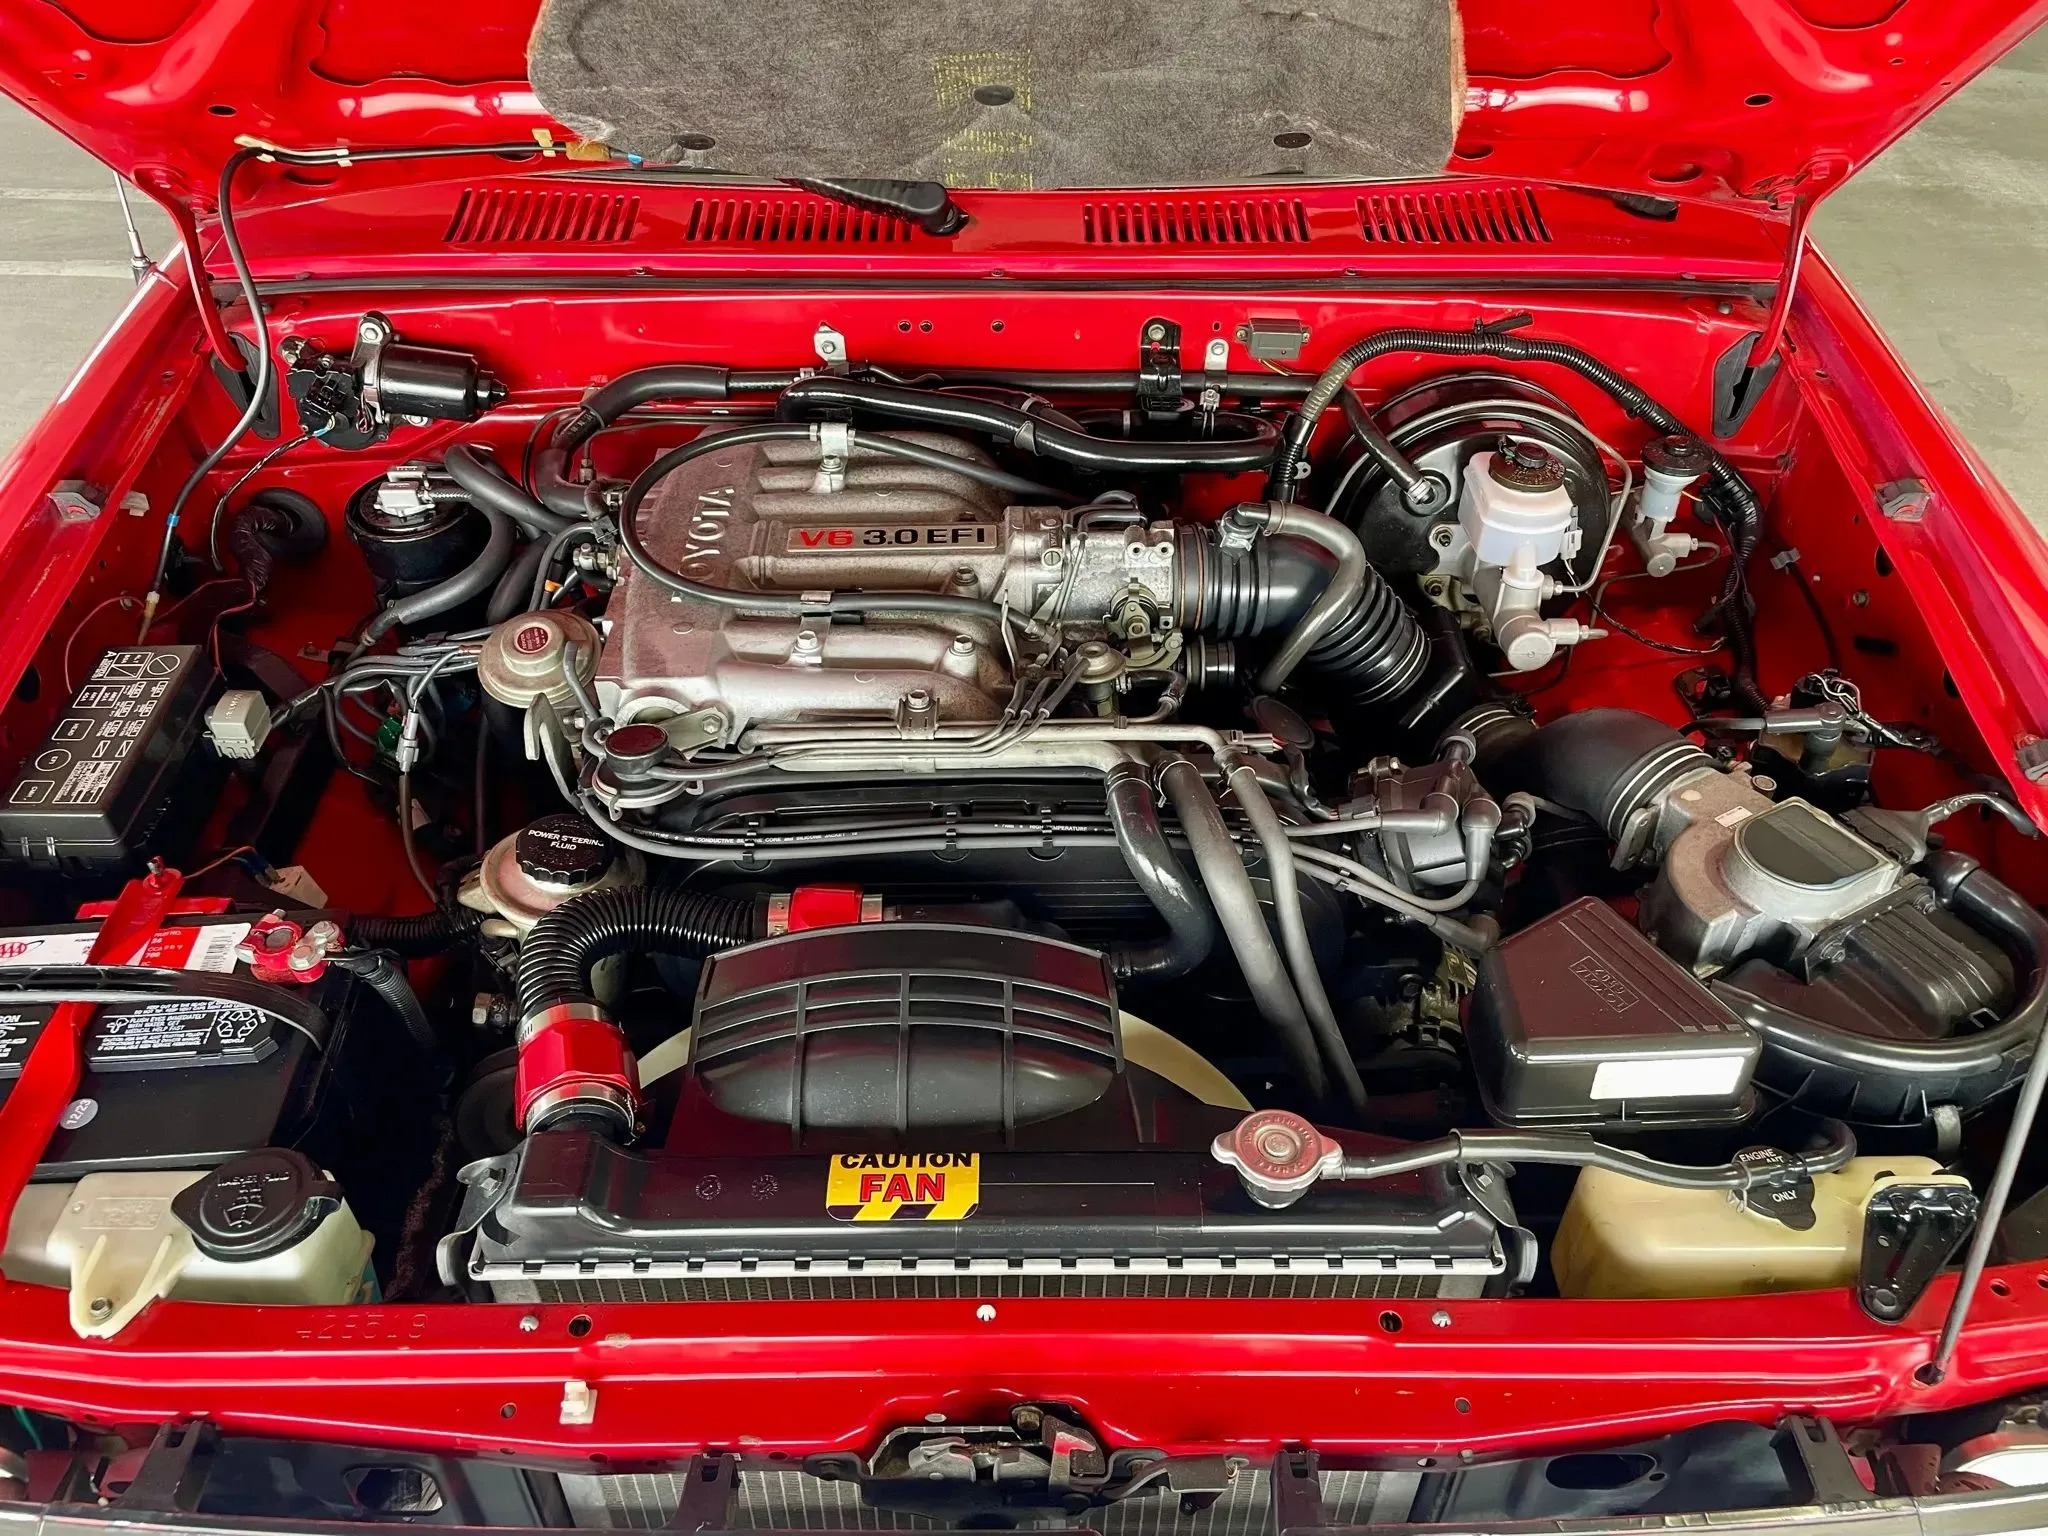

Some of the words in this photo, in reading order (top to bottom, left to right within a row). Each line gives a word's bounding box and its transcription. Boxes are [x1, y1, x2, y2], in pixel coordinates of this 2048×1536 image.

[800, 529, 853, 547] V6
[862, 528, 919, 545] 3.0
[926, 527, 985, 545] EFI
[528, 829, 560, 841] POWER
[550, 840, 577, 851] FLUID
[167, 1013, 208, 1021] IMMEDIATELY
[66, 1099, 91, 1125] 12/23
[840, 1152, 973, 1169] CAUTION
[1739, 1148, 1777, 1162] ENGINE
[860, 1173, 946, 1203] FAN
[1772, 1189, 1798, 1203] ONLY
